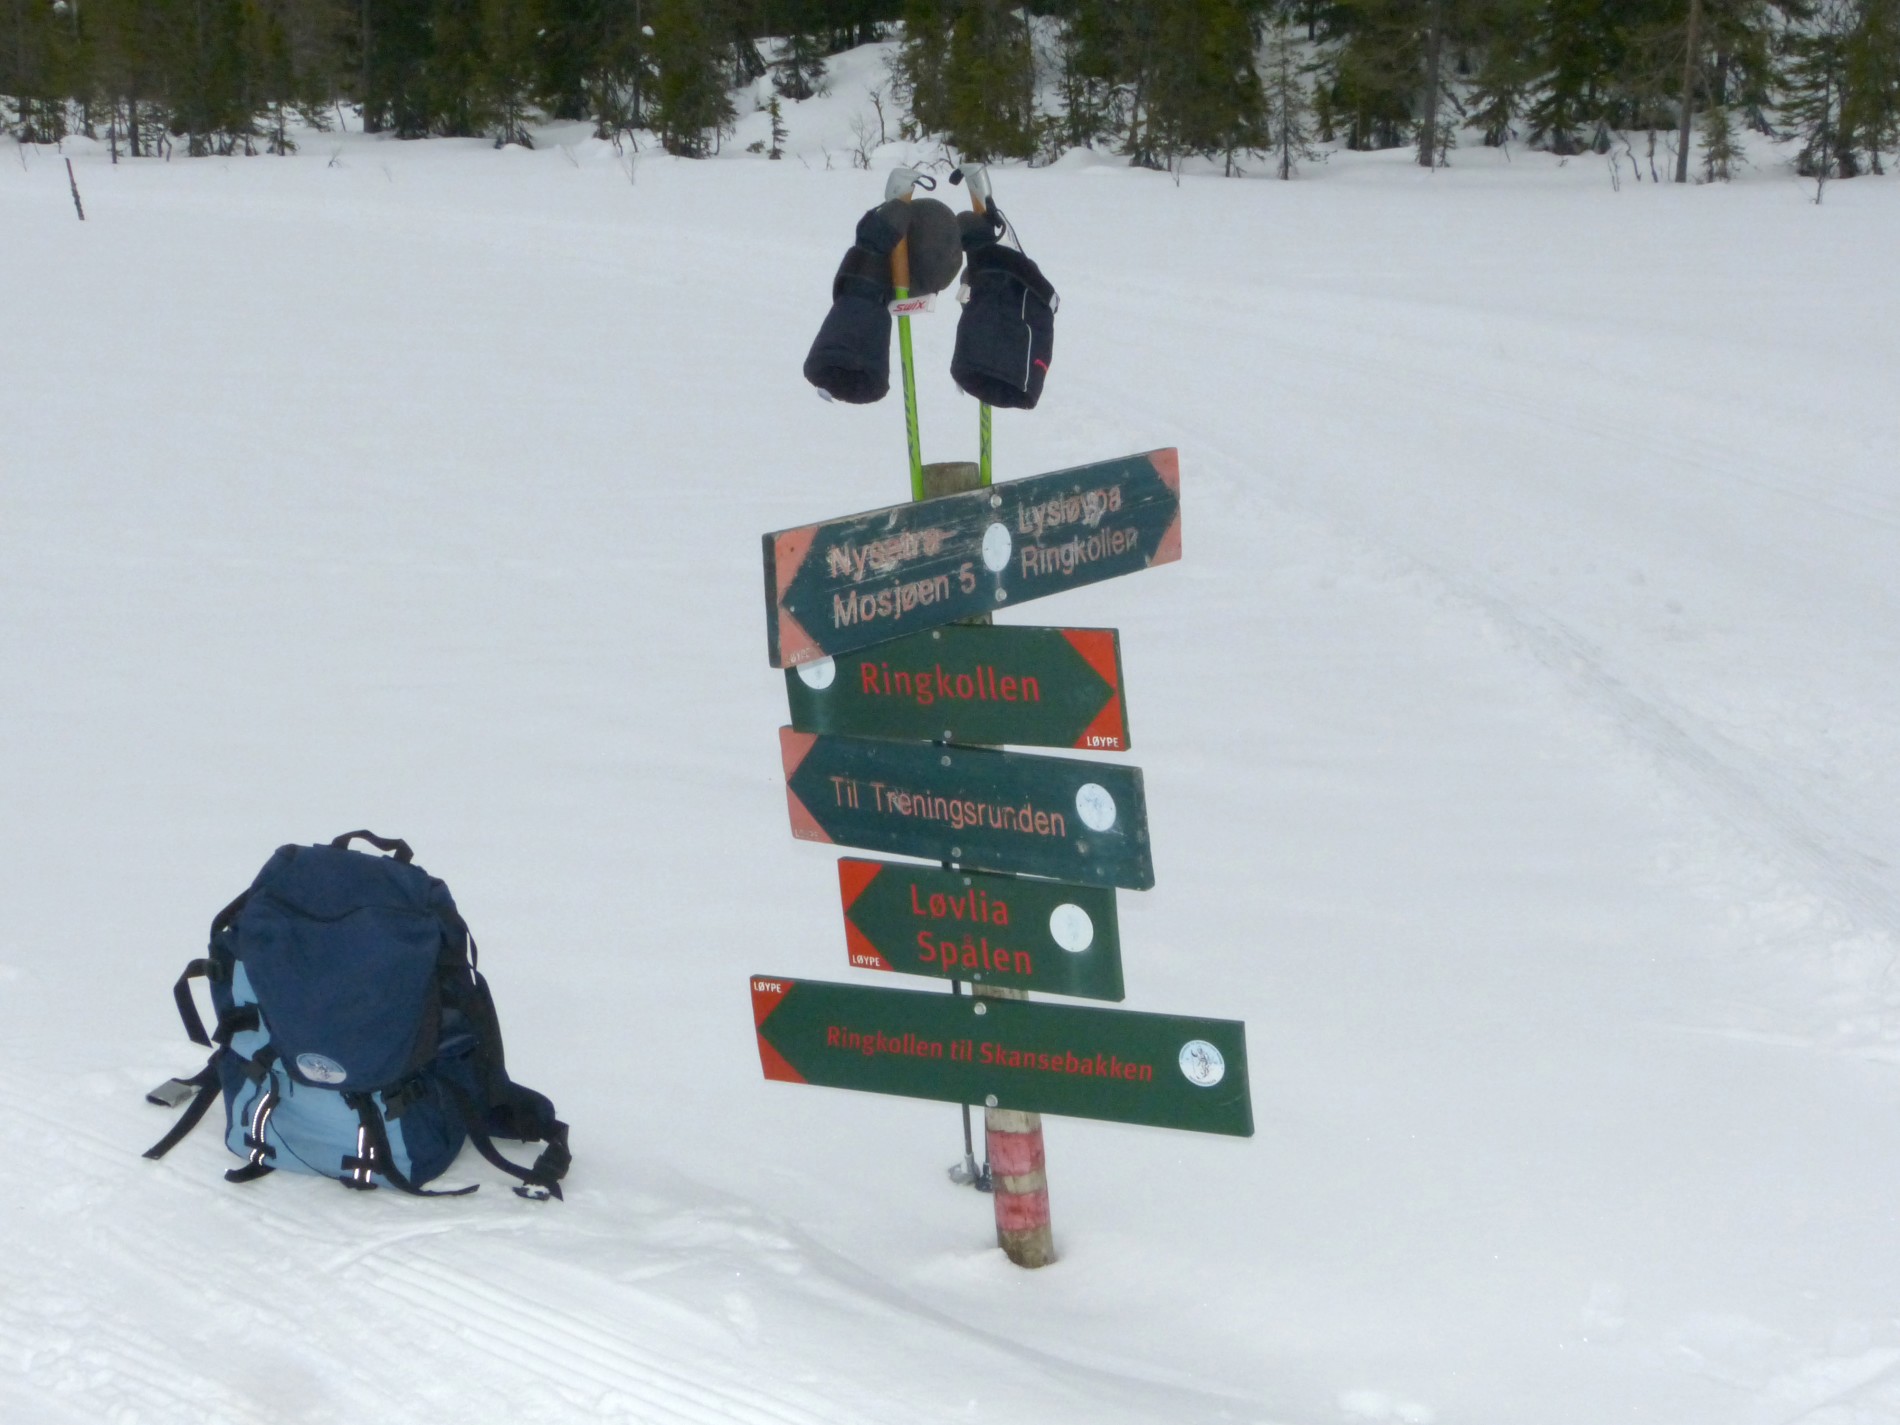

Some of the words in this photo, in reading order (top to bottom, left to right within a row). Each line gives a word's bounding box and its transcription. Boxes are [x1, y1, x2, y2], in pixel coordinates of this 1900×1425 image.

[1021, 526, 1139, 579] Ringkollen
[834, 574, 949, 629] Mosjøen
[960, 562, 976, 594] 5
[860, 662, 1040, 705] Ringkollen
[1086, 735, 1119, 748] LØYPE
[830, 776, 859, 809] Til
[871, 782, 1066, 837] Treningsrunden
[911, 884, 1009, 926] Løvlia
[852, 954, 881, 967] LØYPE
[917, 932, 1032, 975] Spålen
[753, 981, 782, 994] LØYPE
[826, 1026, 943, 1060] Ringkollen
[950, 1040, 972, 1061] til
[980, 1042, 1153, 1083] Skansebakken
